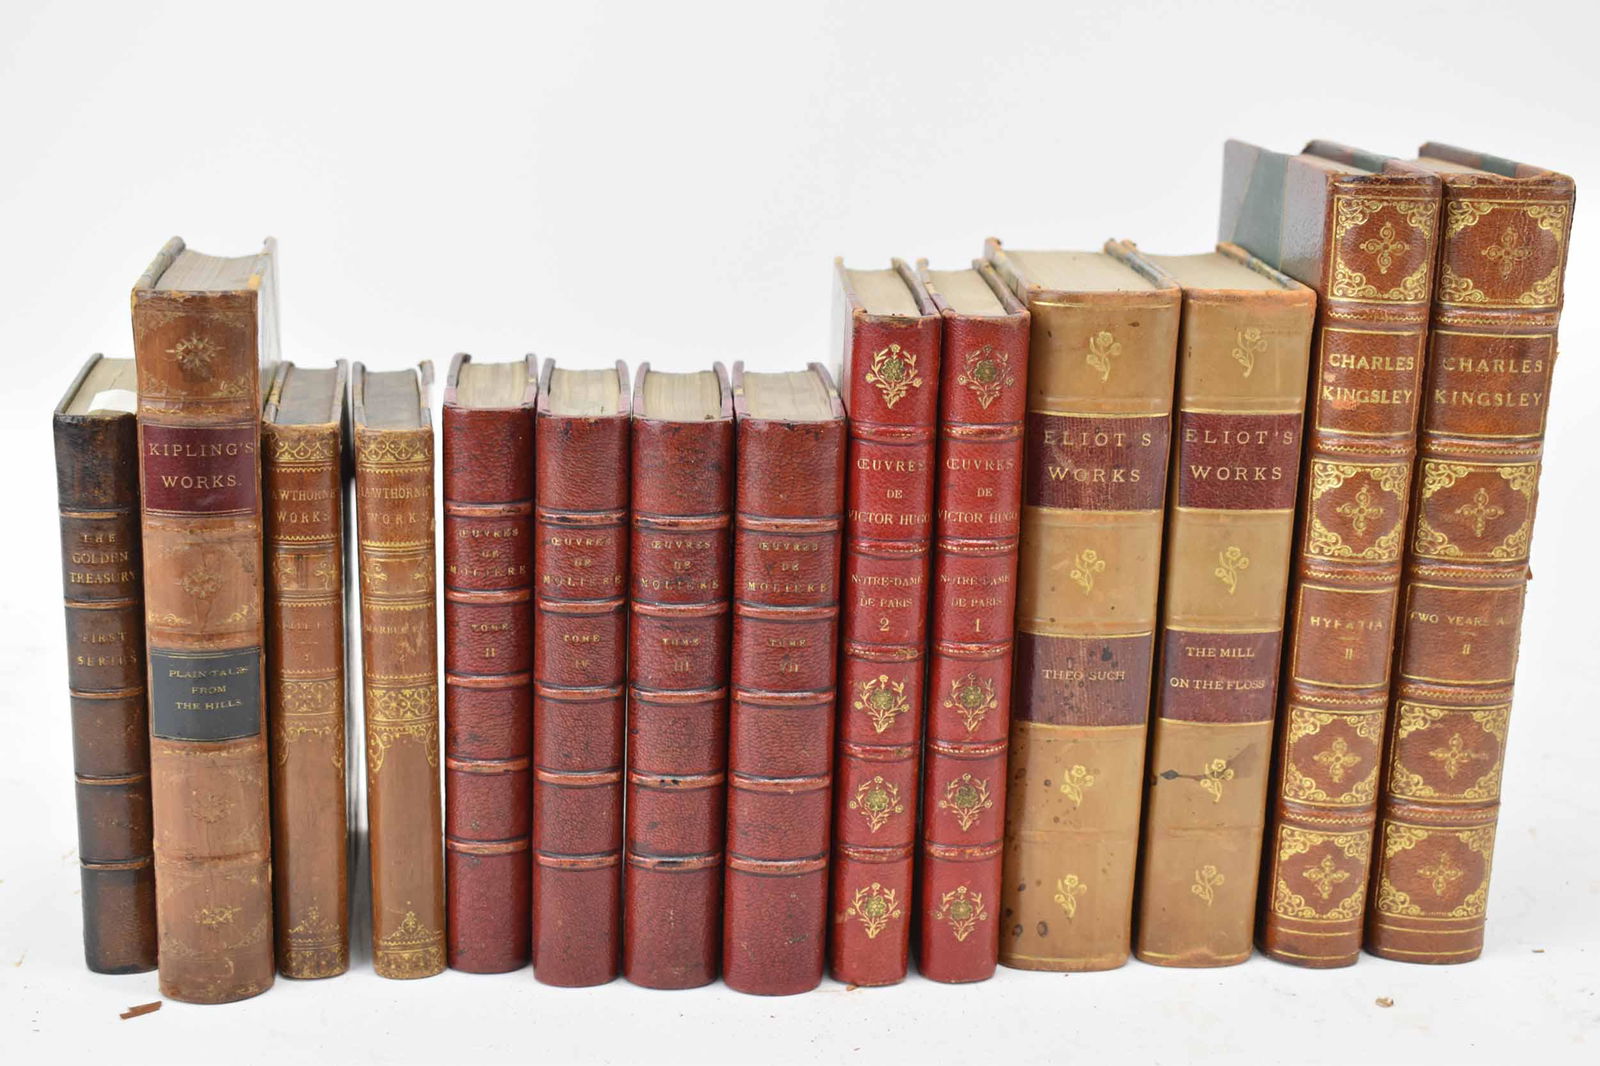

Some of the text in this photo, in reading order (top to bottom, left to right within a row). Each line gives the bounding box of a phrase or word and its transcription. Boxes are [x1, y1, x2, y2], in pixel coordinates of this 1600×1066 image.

[1329, 353, 1415, 371] CHARLES
[1443, 358, 1543, 374] CHARLES
[1322, 386, 1413, 405] KINGSLEY
[1434, 389, 1543, 407] KINGSLEY
[149, 442, 255, 457] KIPLING'S
[1048, 467, 1141, 483] WORKS
[1190, 465, 1283, 482] WORKS
[887, 489, 903, 499] DE
[977, 487, 993, 498] DE
[276, 511, 331, 524] WORKS
[848, 510, 931, 526] VICTOR HUGO
[938, 509, 983, 524] VICTOR
[72, 552, 129, 565] GOLDEN
[879, 618, 890, 632] 2
[1186, 646, 1255, 657] THE MILL
[1089, 670, 1126, 680] SUCH
[191, 686, 227, 694] FROM
[1170, 678, 1266, 690] ON THE FLOSS
[176, 701, 200, 710] THE
